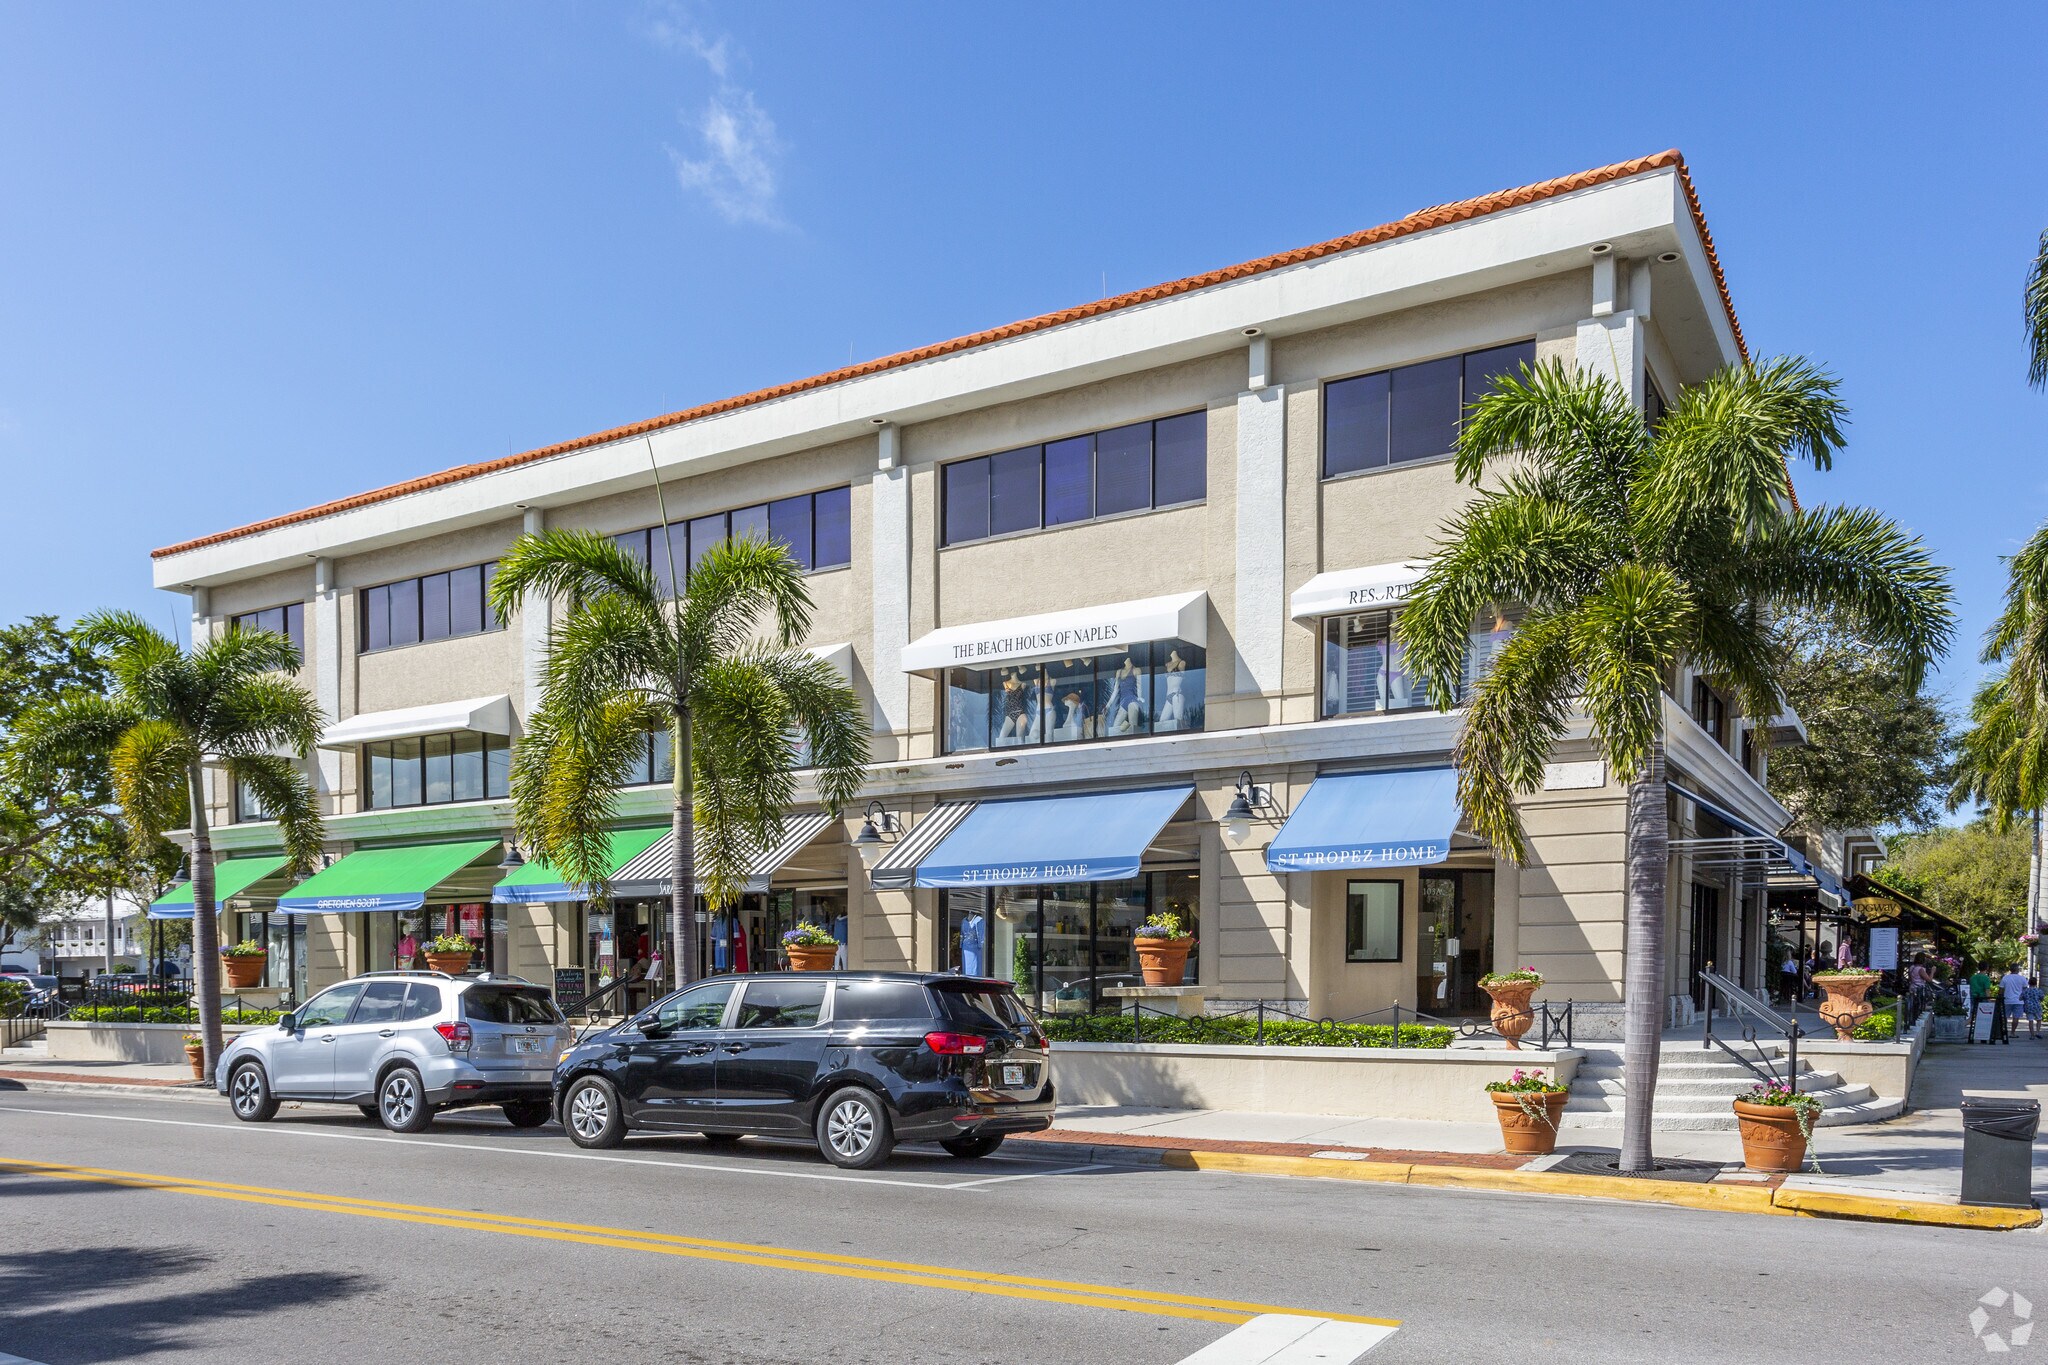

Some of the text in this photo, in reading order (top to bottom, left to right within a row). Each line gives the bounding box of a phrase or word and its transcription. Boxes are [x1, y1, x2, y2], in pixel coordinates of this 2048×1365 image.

[952, 624, 1118, 659] THE BEACH HOUSE OF NAPLES
[1381, 845, 1437, 861] HOME
[1044, 864, 1088, 878] HOME
[317, 897, 381, 909] GRETCHEN SCOTT
